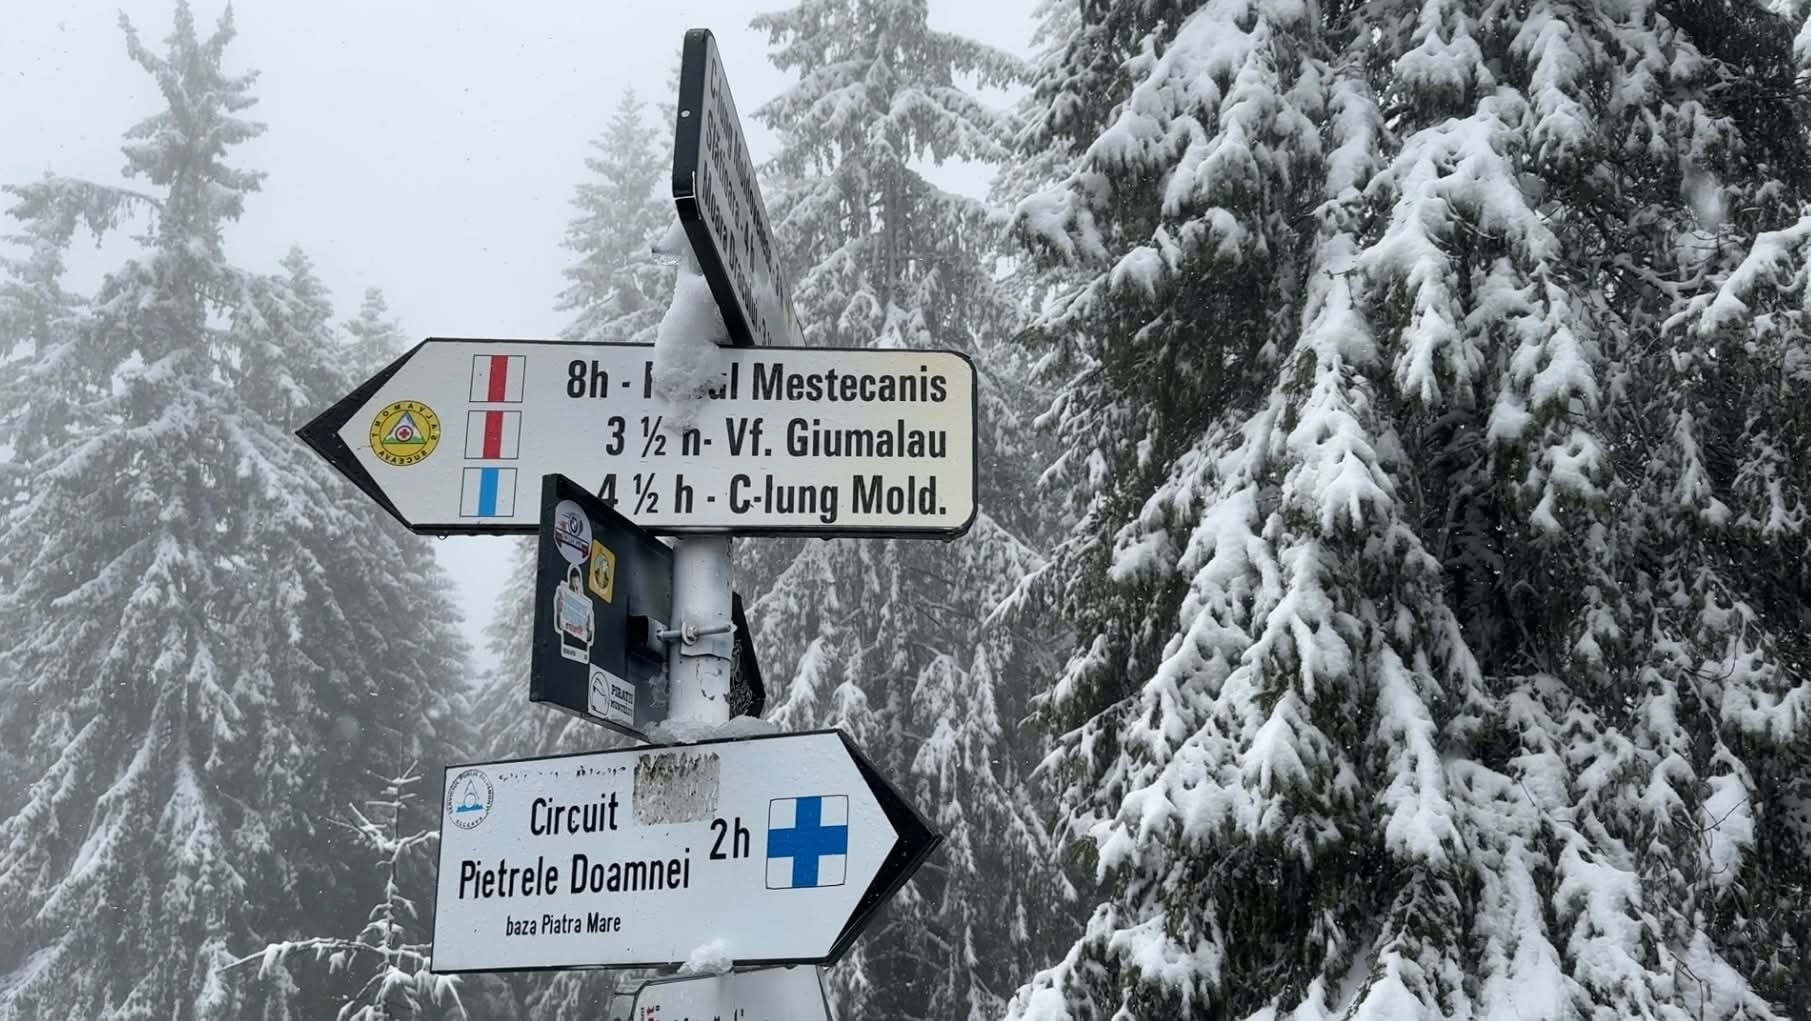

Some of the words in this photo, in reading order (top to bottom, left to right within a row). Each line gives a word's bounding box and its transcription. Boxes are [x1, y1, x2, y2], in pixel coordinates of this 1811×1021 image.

[566, 359, 609, 399] 8h
[752, 362, 947, 403] Mestecanis
[606, 415, 626, 456] 3
[725, 417, 772, 457] Vf.
[786, 417, 947, 458] Giumalau
[674, 474, 694, 514] h
[729, 473, 838, 524] C-lung
[852, 474, 946, 515] Mold.
[530, 791, 619, 836] Circuit
[709, 816, 750, 861] 2h
[458, 855, 559, 900] Pietrele
[570, 848, 690, 894] Doamnei
[506, 915, 537, 937] baza
[541, 913, 582, 935] Piatra
[586, 911, 621, 933] Mare
